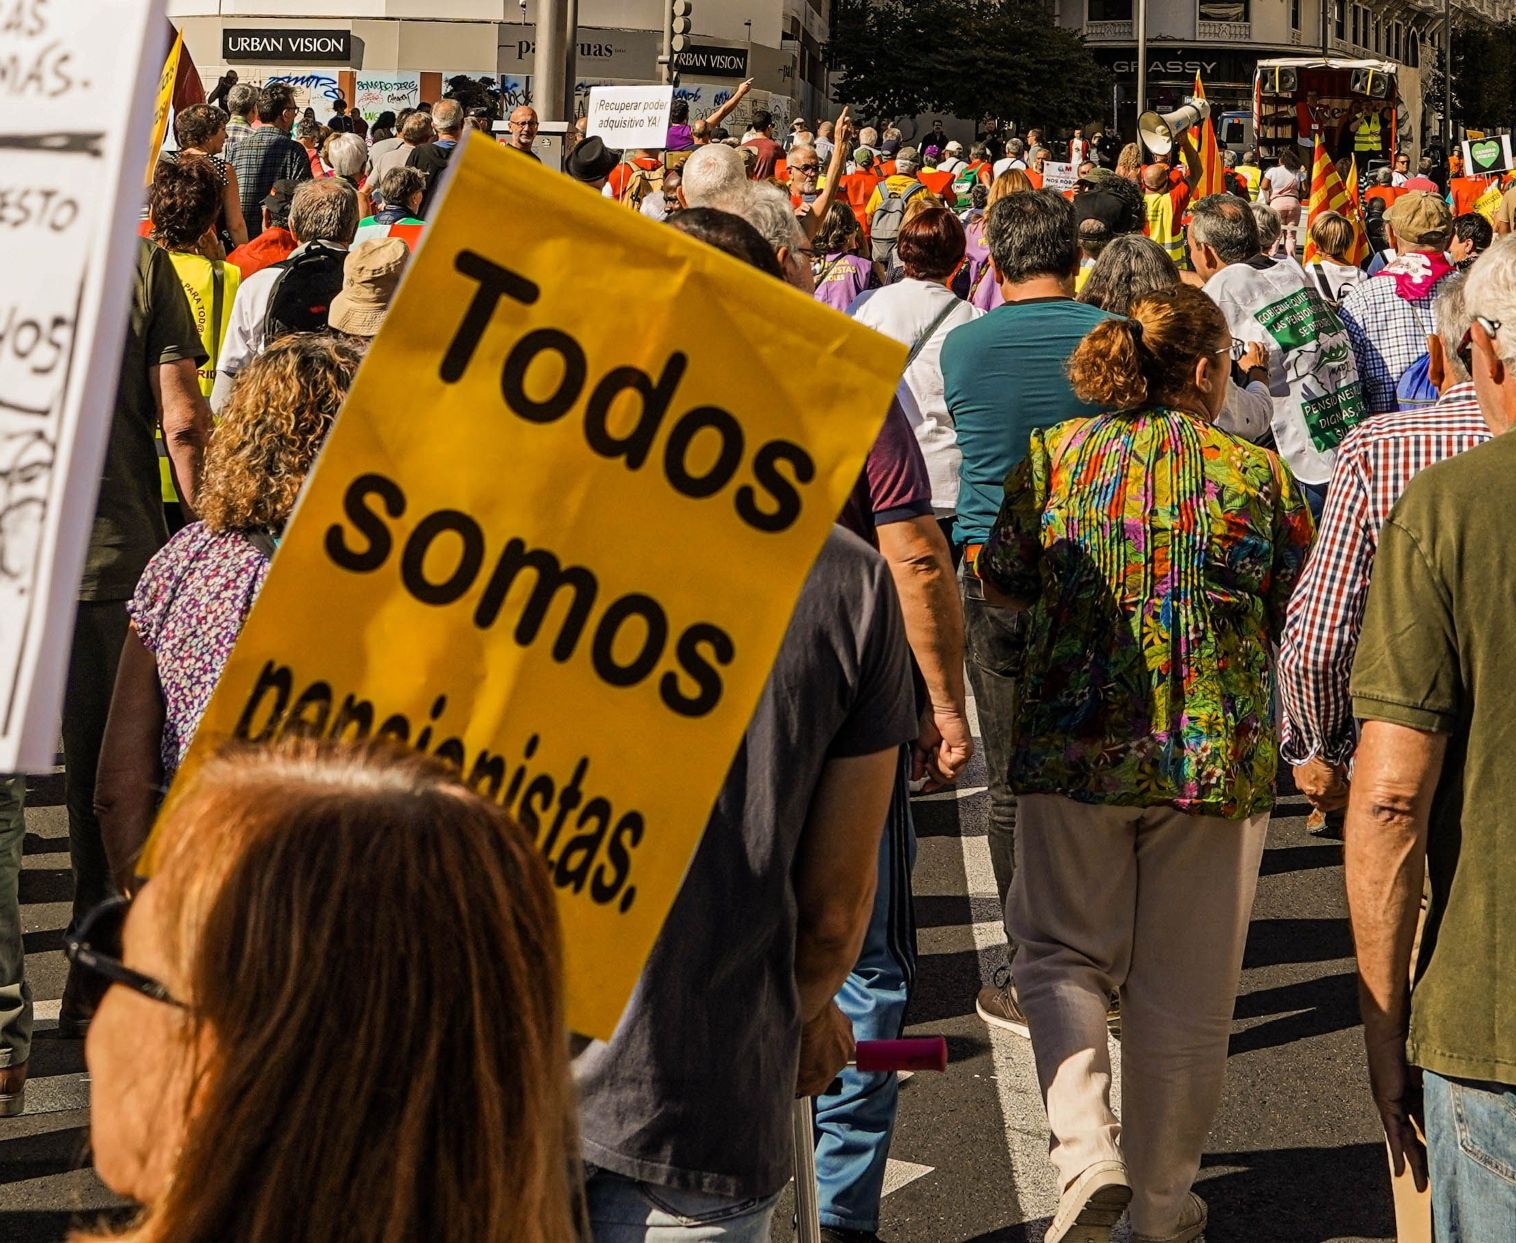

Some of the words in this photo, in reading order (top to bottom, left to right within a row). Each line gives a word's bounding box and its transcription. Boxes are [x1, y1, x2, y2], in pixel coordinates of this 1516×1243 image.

[228, 37, 283, 52] URBAN
[288, 37, 344, 53] VISION
[679, 52, 708, 67] RBAN
[710, 55, 744, 69] VISION
[594, 99, 642, 114] ¡Recuperar
[643, 99, 668, 113] poder
[598, 116, 645, 131] adquisitivo
[439, 250, 814, 533] Todos
[326, 472, 735, 718] somos
